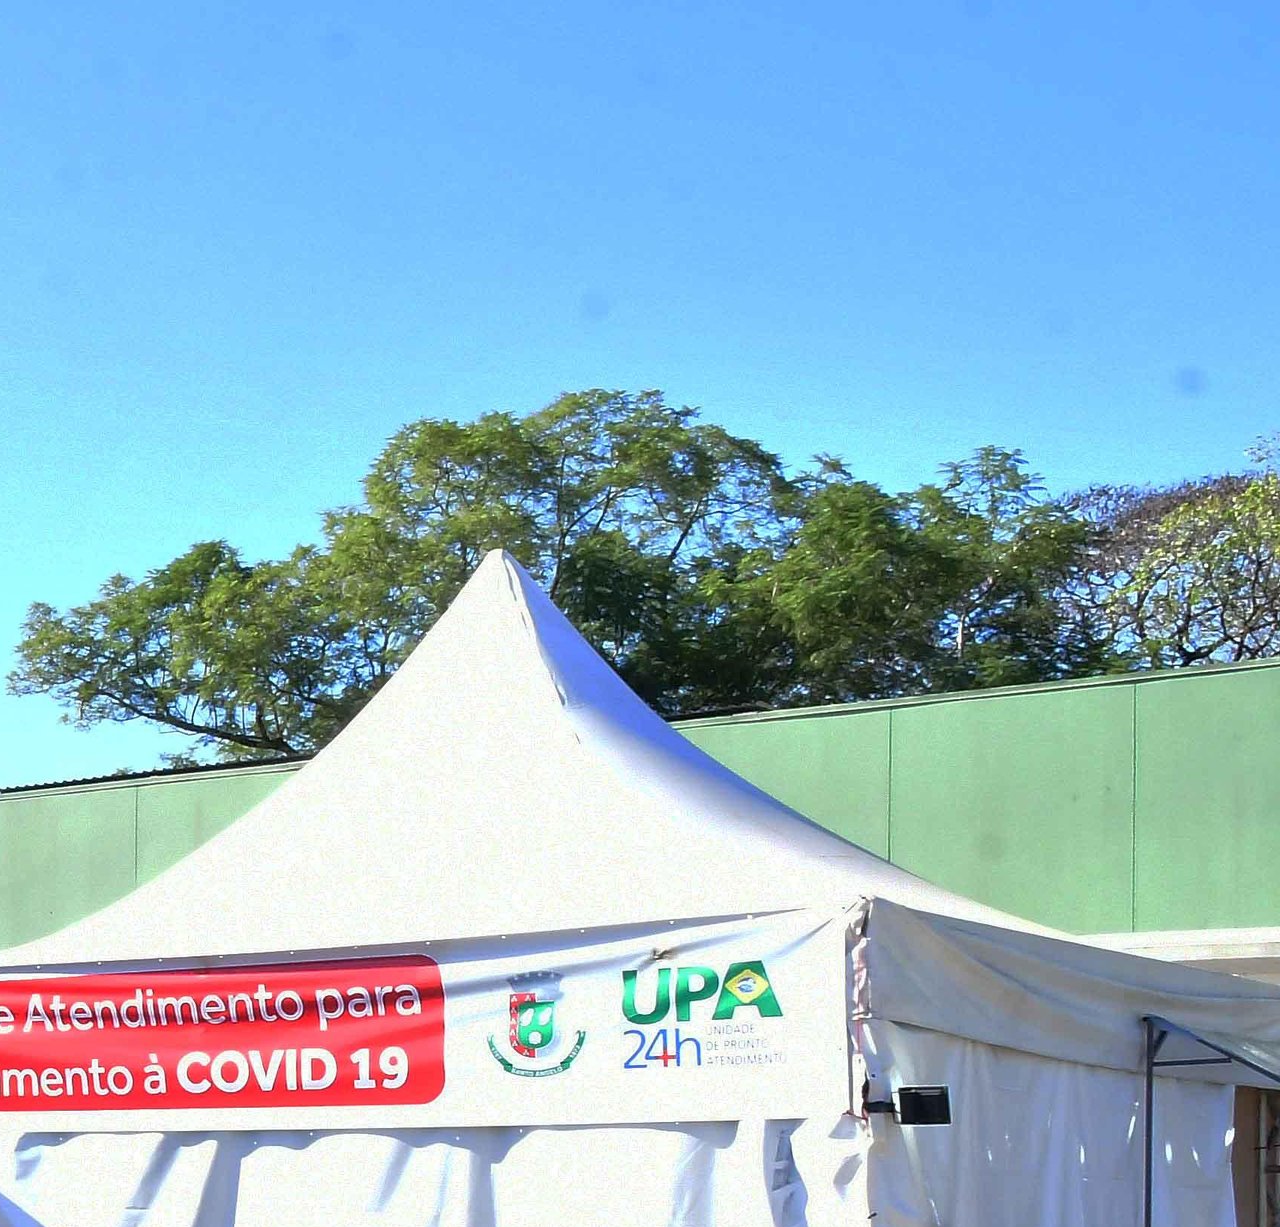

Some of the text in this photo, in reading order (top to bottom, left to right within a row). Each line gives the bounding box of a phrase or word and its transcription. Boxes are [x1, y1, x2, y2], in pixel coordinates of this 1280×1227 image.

[22, 984, 305, 1033] Atendimento
[315, 984, 422, 1031] para
[621, 960, 784, 1025] UPA
[623, 1028, 702, 1070] 24h
[705, 1024, 755, 1035] UNIDADE
[706, 1039, 769, 1051] DE PRONTO
[143, 1053, 167, 1095] à
[176, 1048, 338, 1094] COVID
[349, 1047, 409, 1090] 19
[707, 1052, 787, 1065] ATENDIMENTO
